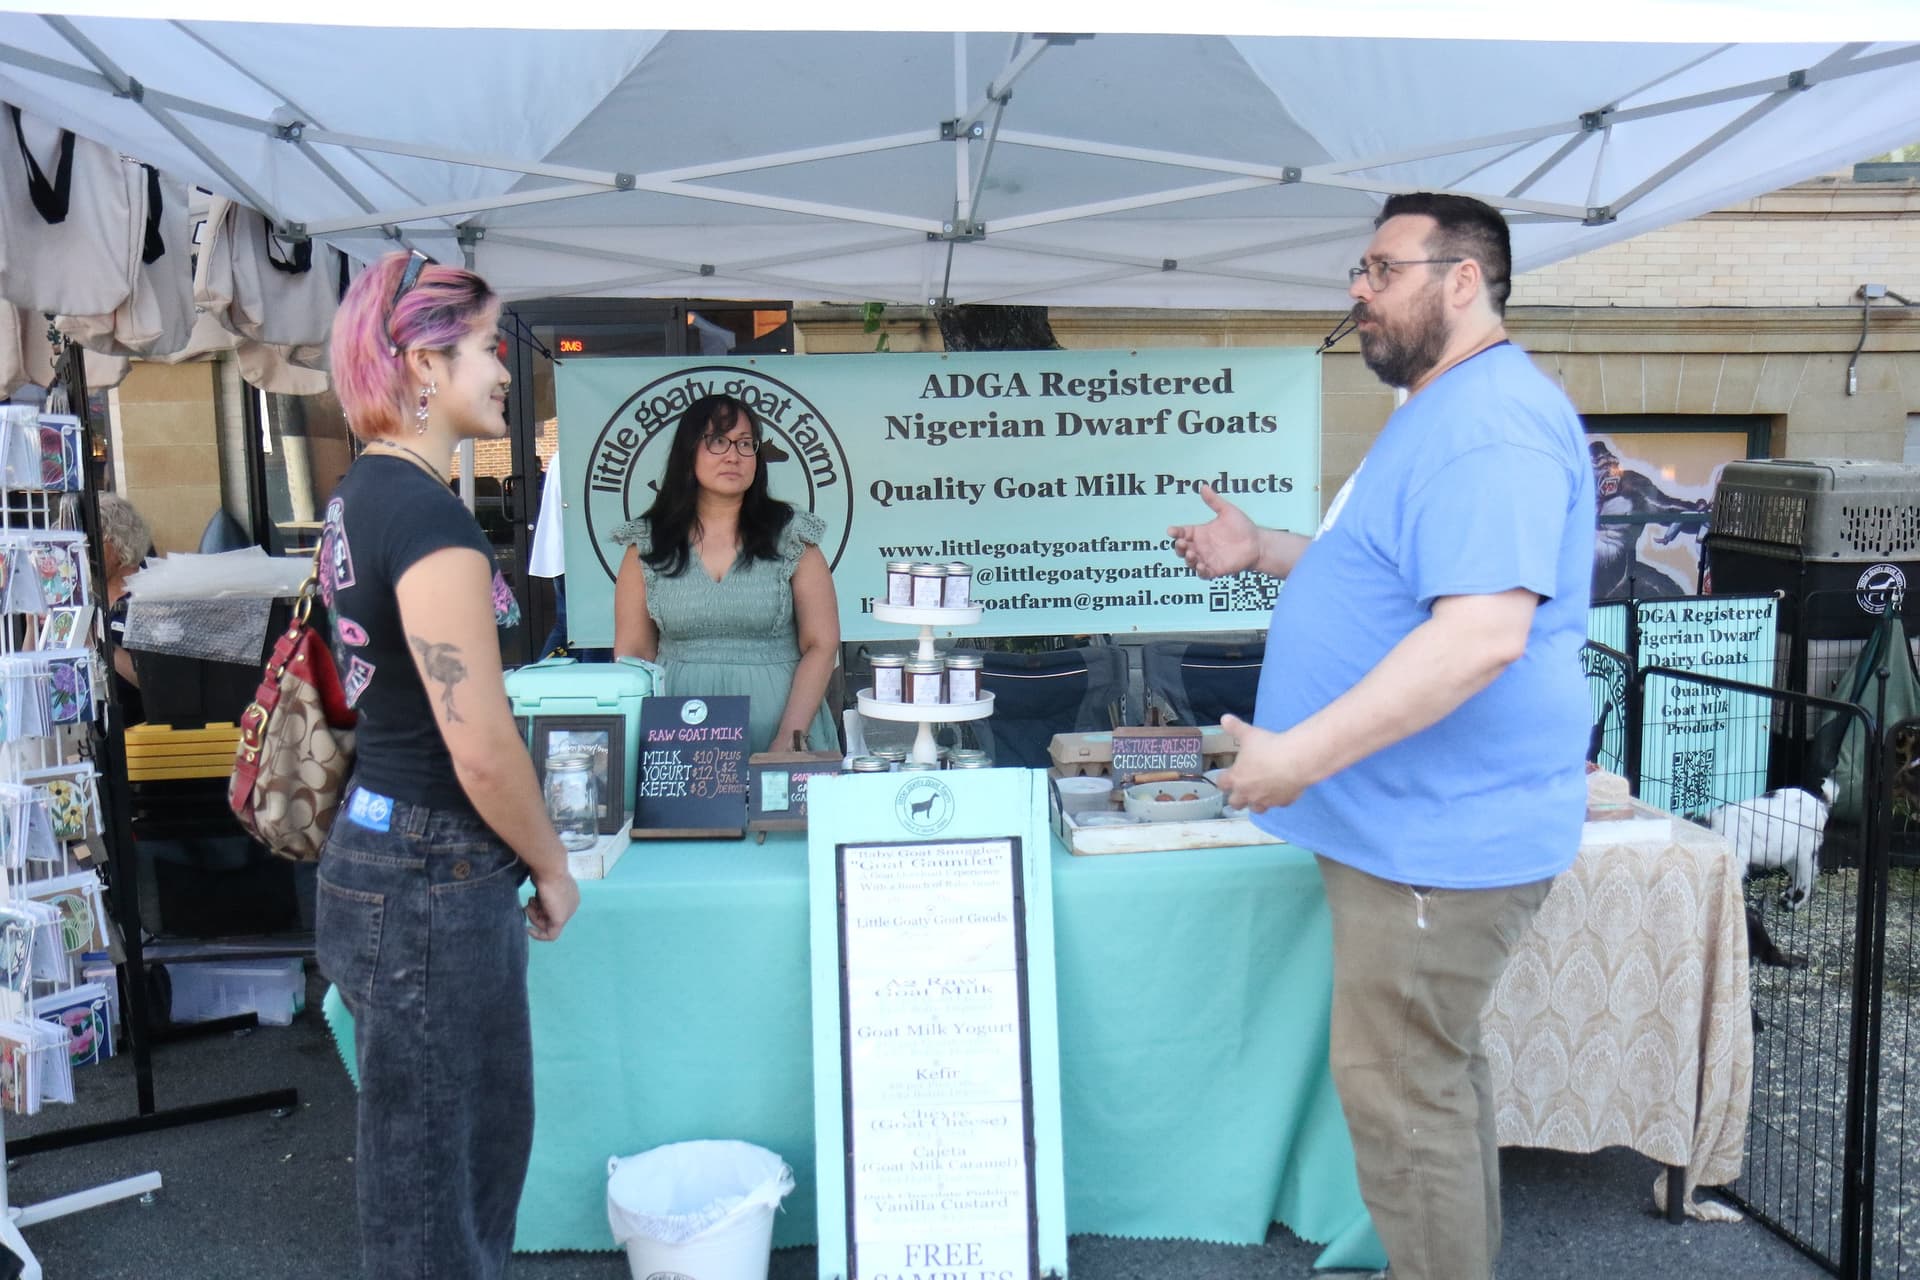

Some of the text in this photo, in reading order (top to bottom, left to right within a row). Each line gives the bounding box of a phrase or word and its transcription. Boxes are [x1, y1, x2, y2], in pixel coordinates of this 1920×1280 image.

[919, 368, 1234, 403] ADGA Registered
[591, 378, 837, 493] little goaty goat farm
[884, 408, 1278, 447] Nigerian Dwarf Goats
[869, 471, 1293, 507] Quality Goat Milk Products
[879, 537, 1178, 560] www.littlegoatygoatfarm.c
[1683, 604, 1773, 625] Registered
[1710, 626, 1762, 643] Dwarf
[1647, 651, 1748, 669] Dairy Goats
[1671, 684, 1722, 700] Quality
[1662, 700, 1728, 717] Goat Milk
[648, 727, 743, 741] RAW GOAT MILK
[1666, 720, 1726, 735] Products
[1112, 738, 1200, 754] PASTURE-RAISED
[643, 750, 713, 765] MILK $10
[720, 751, 741, 760] PLUS
[1113, 754, 1198, 770] CHICKEN EGGS
[643, 765, 713, 781] YOGURT $12
[721, 761, 737, 773] $2
[720, 773, 739, 783] JAR
[640, 780, 708, 797] KEFIR $8
[857, 917, 890, 928] Little
[967, 912, 1008, 924] Goods
[857, 1022, 1014, 1038] Goat Milk Yogurt
[916, 1067, 959, 1080] Kefir
[913, 1146, 967, 1159] Cajeta
[909, 1159, 943, 1172] Milk
[874, 1197, 1009, 1214] Vanilla Custard
[904, 1241, 984, 1267] FREE
